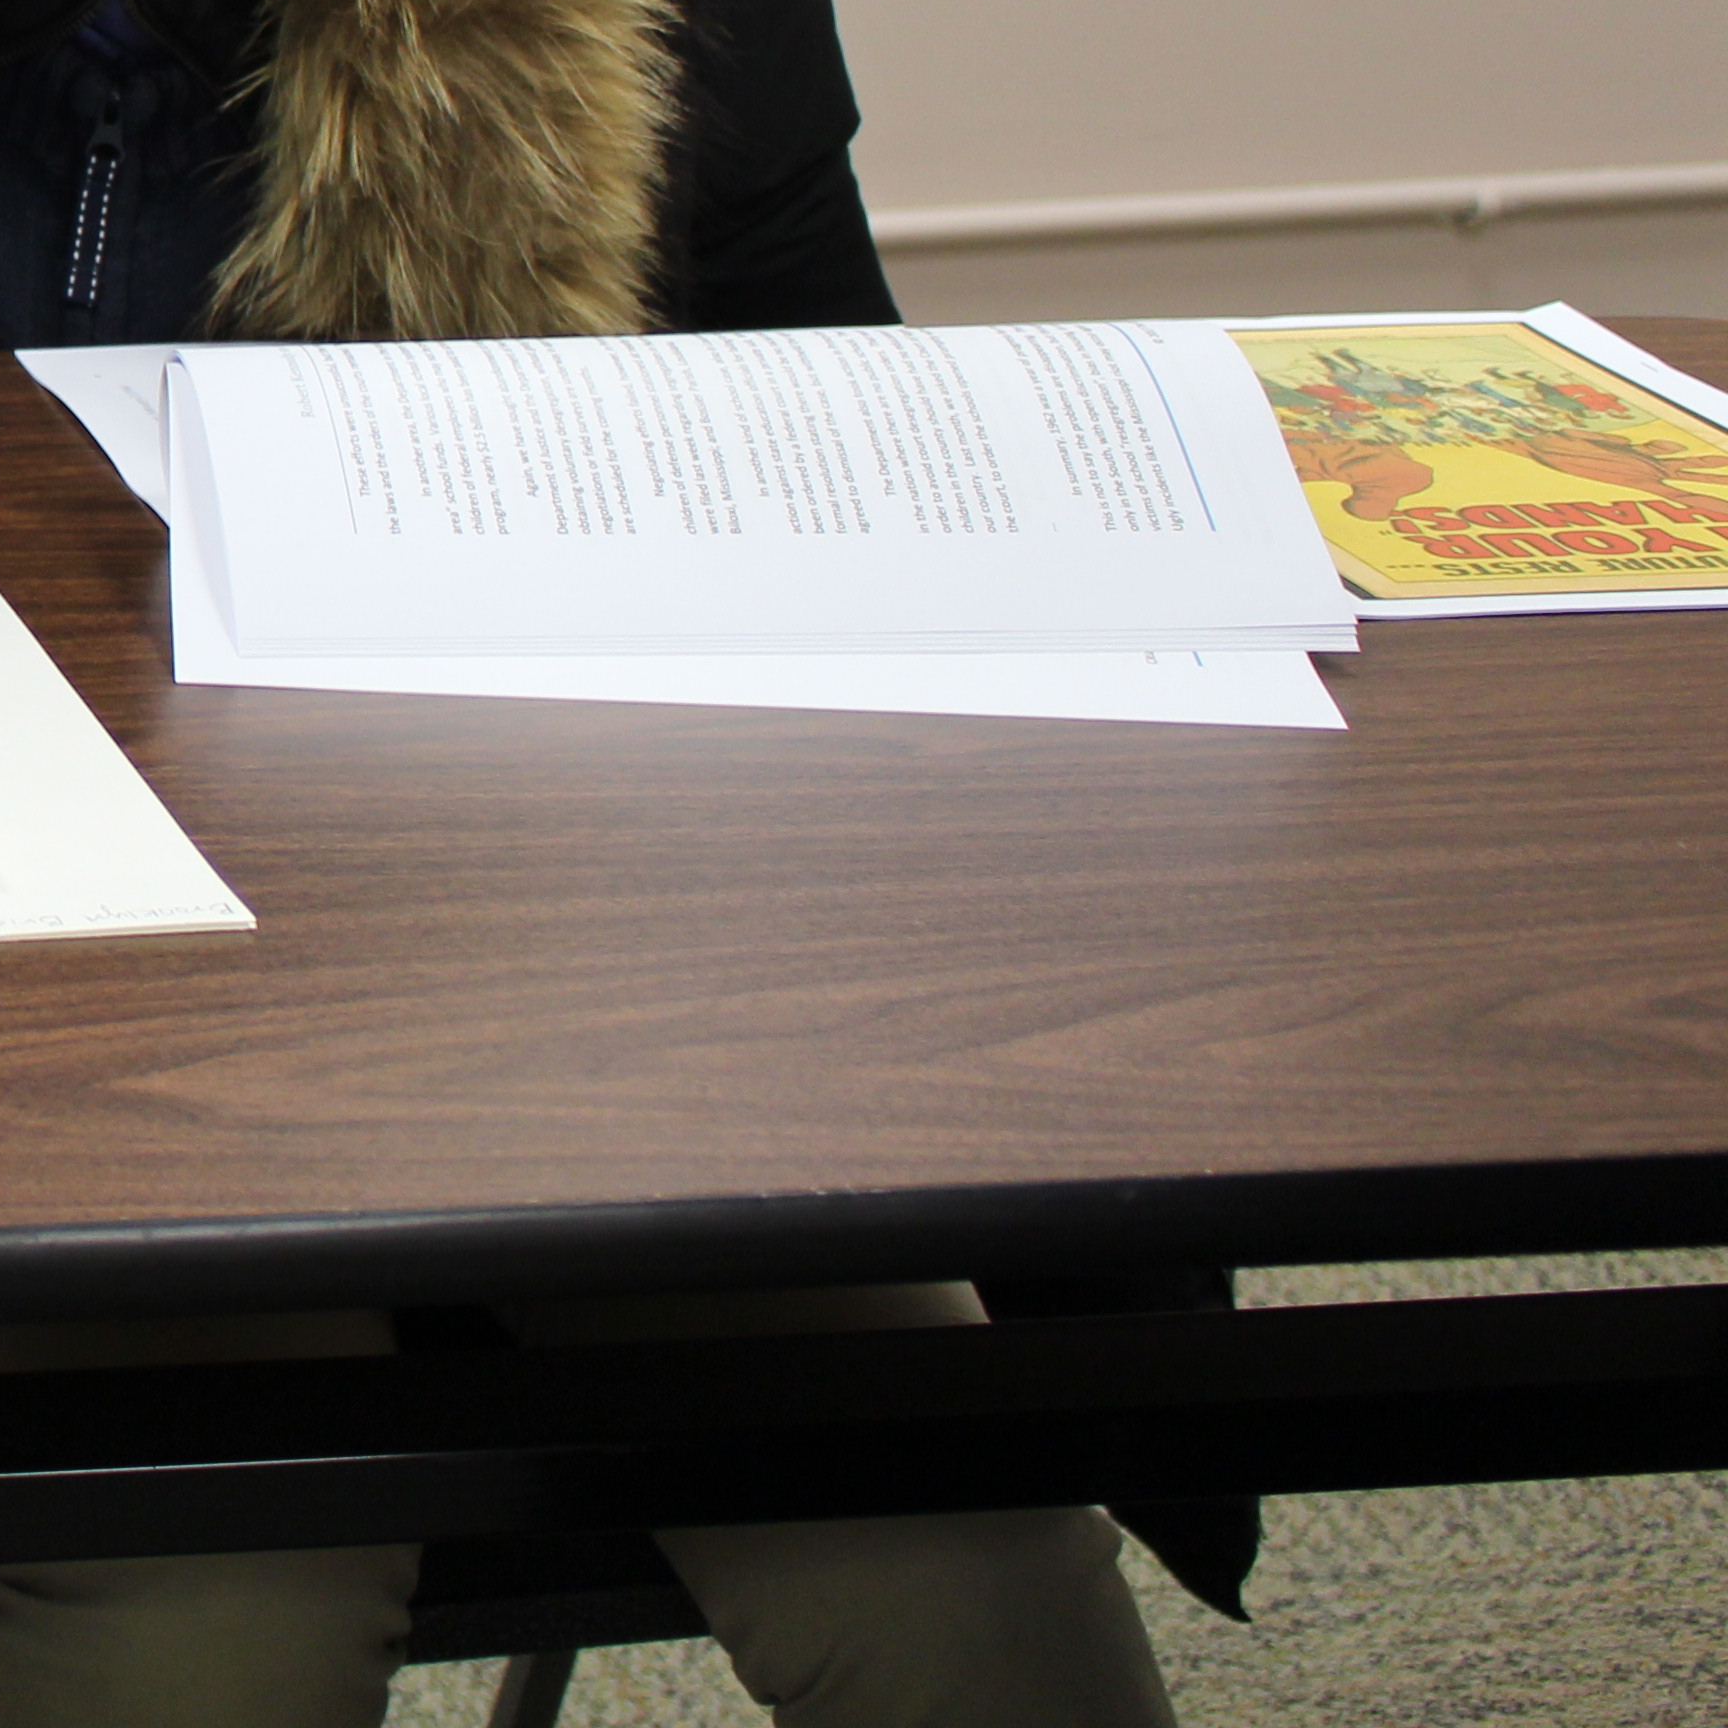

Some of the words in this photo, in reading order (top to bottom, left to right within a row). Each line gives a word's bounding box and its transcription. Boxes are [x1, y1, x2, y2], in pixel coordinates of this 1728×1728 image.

[444, 395, 464, 442] employees
[692, 394, 711, 424] Bossier
[1057, 390, 1084, 432] problems
[1083, 399, 1100, 422] open
[368, 420, 384, 450] orders
[534, 427, 551, 458] Justice
[601, 430, 614, 446] the
[701, 426, 718, 443] and
[1074, 434, 1089, 450] the
[1091, 424, 1108, 445] with
[1137, 427, 1151, 443] the
[605, 448, 619, 462] for
[912, 435, 931, 461] court
[1144, 445, 1158, 461] like
[375, 452, 388, 468] the
[454, 444, 472, 478] federal
[540, 460, 554, 471] of
[1082, 452, 1096, 467] say
[1101, 447, 1121, 478] South,
[1122, 451, 1145, 482] school
[377, 470, 392, 489] and
[919, 463, 940, 490] avoid
[1088, 469, 1100, 480] to
[461, 480, 476, 491] of
[609, 464, 632, 515] scheduled
[883, 478, 896, 496] The
[1091, 482, 1107, 499] not
[1113, 480, 1128, 497] the
[1133, 484, 1149, 495] of
[1151, 463, 1175, 507] incidents
[384, 492, 398, 514] laws
[932, 492, 944, 503] to
[1098, 501, 1110, 509] is
[1120, 498, 1132, 508] in
[468, 493, 486, 535] children
[725, 506, 742, 534] Biloxi,
[936, 505, 953, 534] order
[1102, 512, 1117, 531] This
[1123, 510, 1140, 532] only
[1142, 497, 1162, 532] victims
[1167, 510, 1184, 532] Ugly
[388, 517, 402, 535] the
[624, 518, 637, 534] are
[1404, 528, 1722, 559] YOUR
[1587, 554, 1728, 572] UTURE
